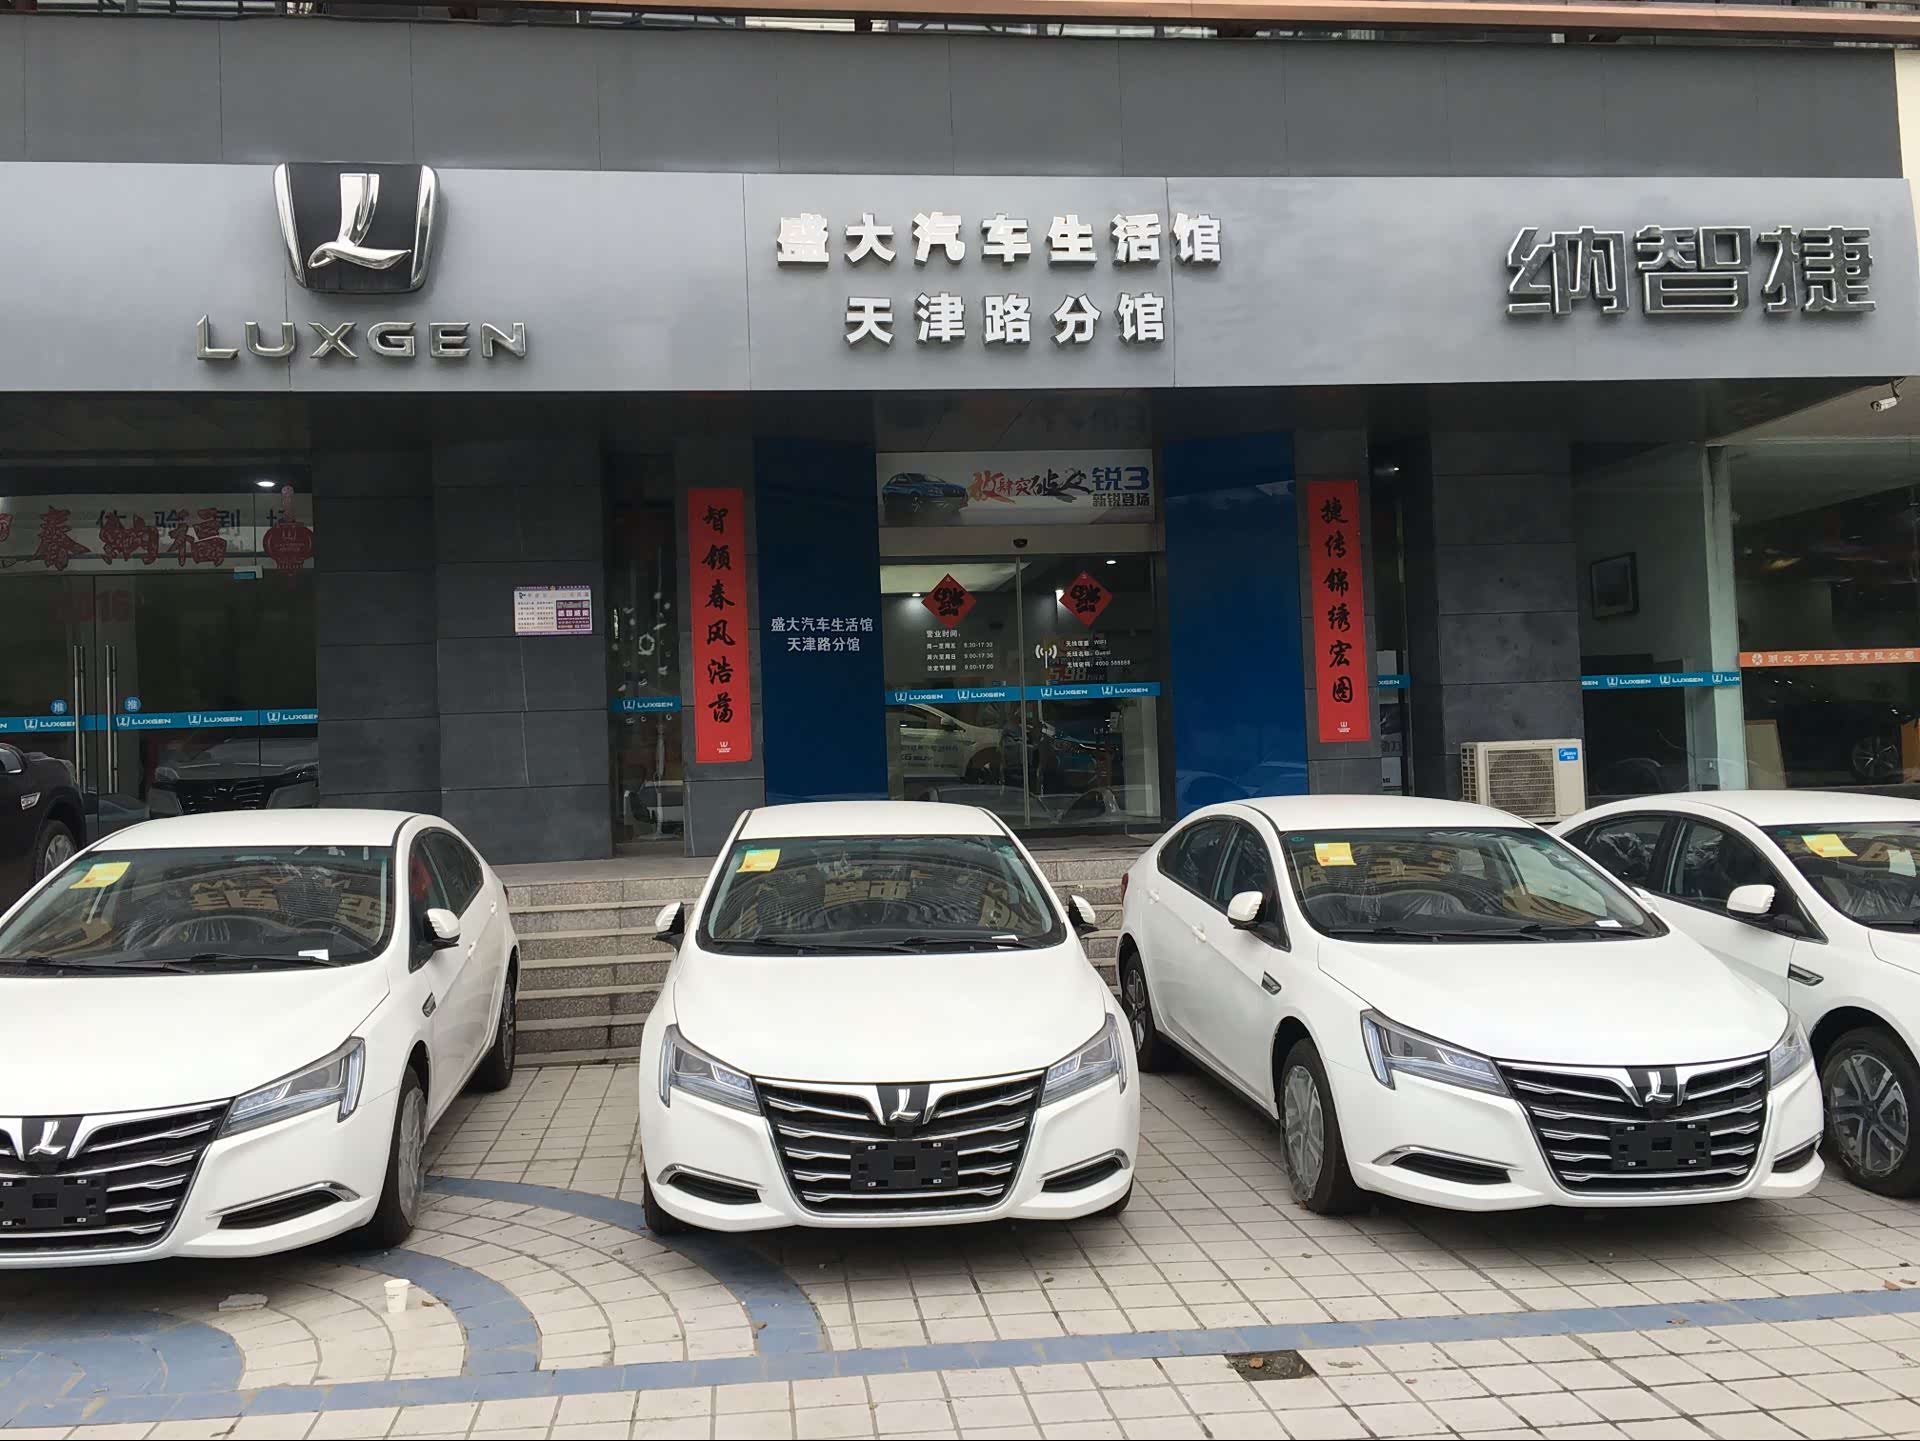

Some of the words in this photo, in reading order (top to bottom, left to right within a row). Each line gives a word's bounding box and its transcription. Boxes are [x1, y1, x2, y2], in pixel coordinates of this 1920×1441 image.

[777, 212, 1223, 266] 盛大汽车生活馆
[1506, 226, 1876, 315] 纳智捷
[845, 292, 1165, 346] 天津路分馆
[197, 315, 527, 360] LUXGEN
[1092, 466, 1150, 491] 锐3
[1092, 492, 1150, 507] 新锐登场
[771, 616, 873, 632] 盛大汽车生活馆
[787, 637, 860, 652] 天津路分馆
[1054, 688, 1088, 696] LUXGEN
[132, 717, 171, 725] LUXGEN
[204, 715, 243, 723] LUXGEN
